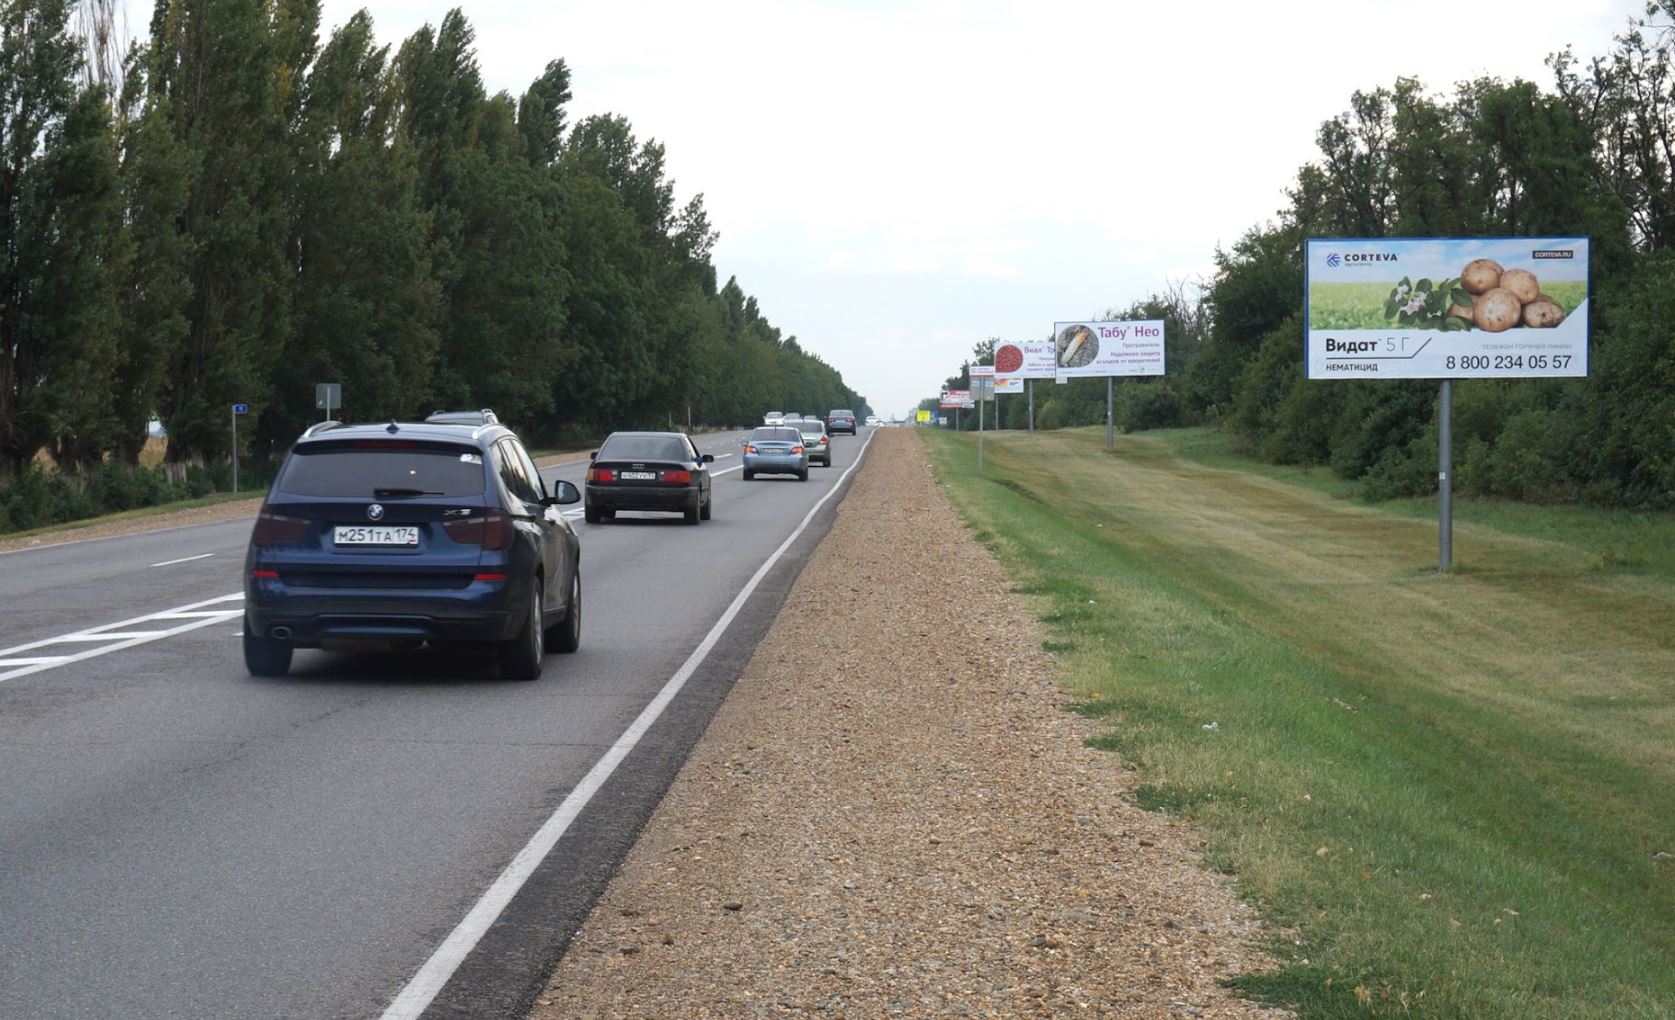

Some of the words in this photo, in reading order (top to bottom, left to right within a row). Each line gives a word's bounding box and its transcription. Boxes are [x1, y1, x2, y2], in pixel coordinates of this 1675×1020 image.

[1344, 253, 1398, 262] CORTEVA
[1098, 326, 1127, 340] Табу
[1135, 326, 1160, 337] Нео
[1326, 338, 1378, 354] Видат
[1386, 337, 1396, 352] 5
[1401, 337, 1410, 352] Г
[1326, 363, 1378, 371] НЕМАТИЦИД
[1446, 355, 1456, 369] 8
[1460, 355, 1490, 369] 800
[1494, 355, 1524, 369] 234
[1528, 355, 1548, 369] 05
[1552, 355, 1572, 368] 57
